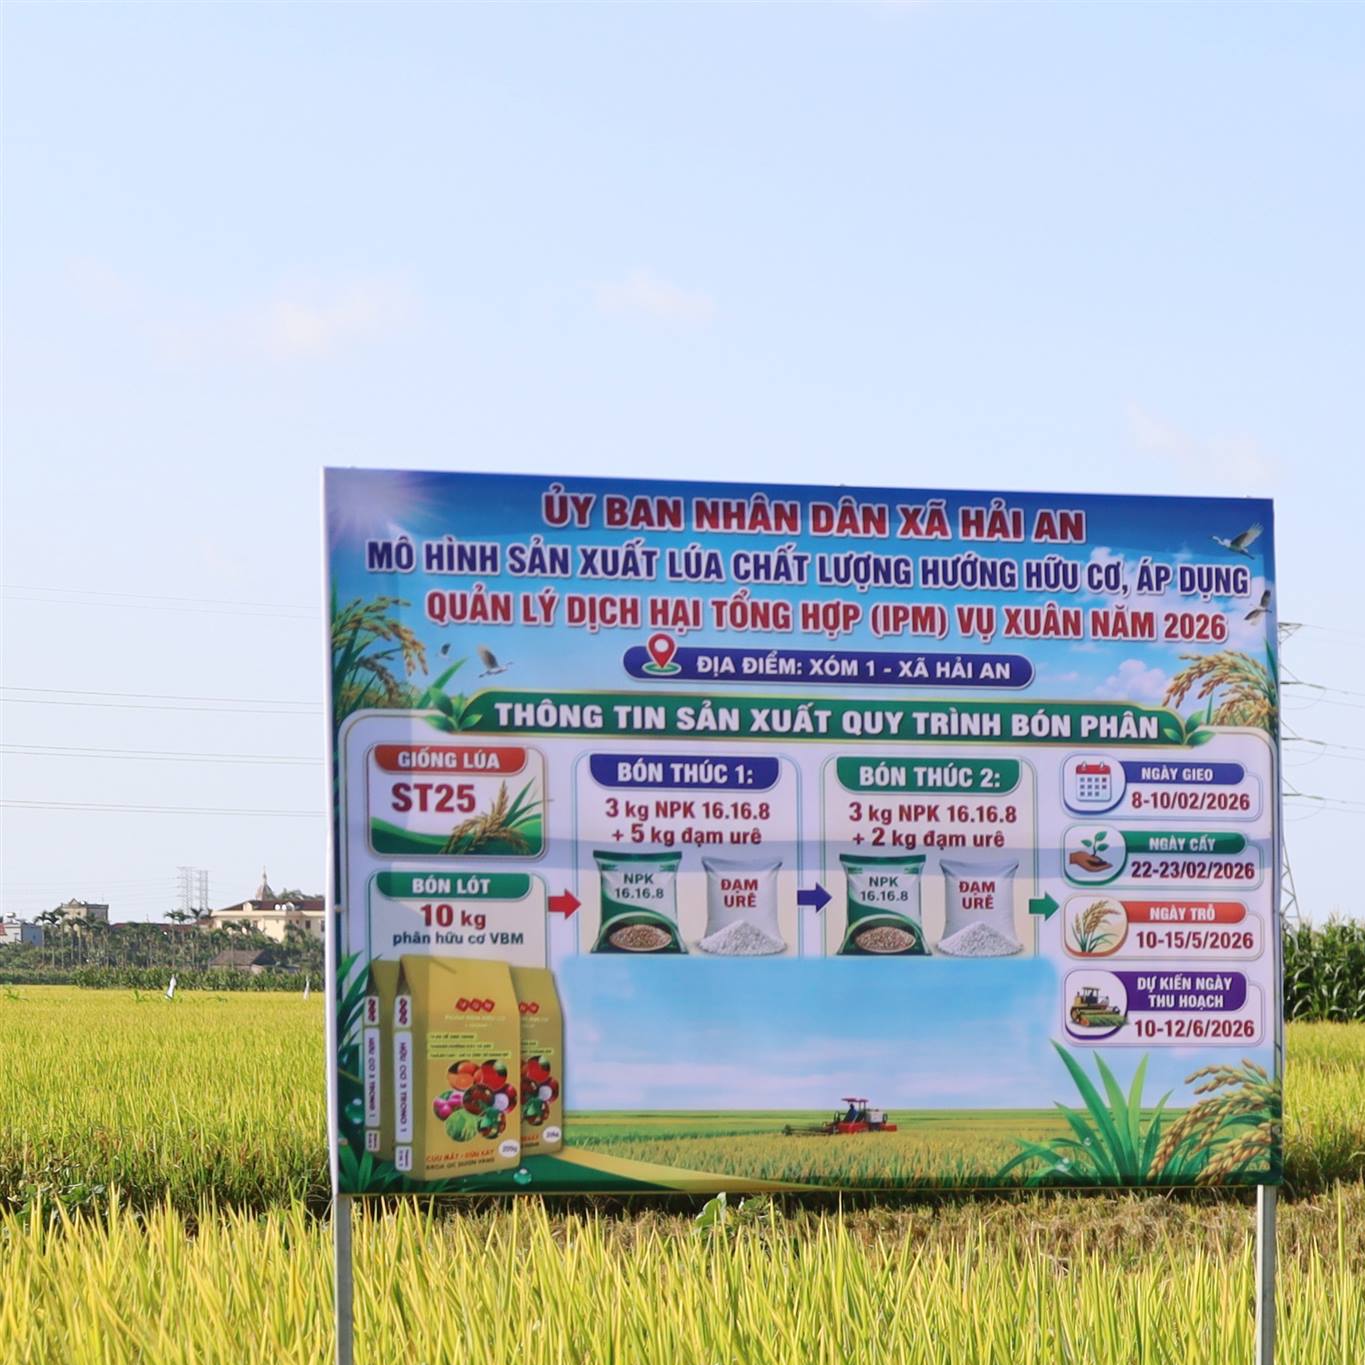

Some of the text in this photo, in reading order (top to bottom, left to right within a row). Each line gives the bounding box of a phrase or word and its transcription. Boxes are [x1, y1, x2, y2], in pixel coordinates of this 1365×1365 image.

[544, 486, 1084, 543] ỦY BAN NHÂN DÂN XÃ HẢI AN
[368, 537, 1248, 599] MÔ HÌNH SẢN XUẤT LÚA CHẤT LƯỢNG HƯỚNG HỮU CƠ, ÁP DỤNG
[427, 583, 1226, 642] QUẢN LÝ DỊCH HẠI TỔNG HỢP (IPM) VỤ XUÂN NĂM 2026
[697, 656, 735, 677] ĐỊA
[742, 651, 802, 675] ĐIỂM:
[809, 654, 857, 677] XÓM
[866, 659, 874, 677] 1
[899, 654, 928, 678] XÃ
[934, 654, 972, 679] HẢI
[979, 662, 1010, 680] AN
[494, 700, 1158, 739] THÔNG TIN SẢN XUẤT QUY TRÌNH BÓN PHÂN
[398, 749, 500, 769] GIỐNG LÚA
[617, 760, 752, 784] BÓN THÚC 1:
[859, 763, 1000, 787] BÓN THÚC 2:
[1142, 764, 1213, 782] NGÀY GIEO
[392, 783, 476, 813] ST25
[1132, 792, 1250, 810] 8-10/02/2026
[606, 799, 769, 821] 3 kg NPK 16.16.8
[849, 802, 1017, 824] 3 kg NPK 16.16.8
[612, 824, 762, 847] + 5 kg đạm urê
[853, 828, 1005, 850] + 2 kg đạm urê
[1150, 834, 1216, 852] NGÀY CẤY
[624, 873, 654, 885] NPK
[1131, 861, 1254, 879] 22-23/02/2026
[412, 874, 490, 895] BÓN LÓT
[721, 879, 758, 895] ĐẠM
[869, 876, 898, 888] NPK
[959, 880, 995, 896] ĐẠM
[614, 888, 664, 899] 16.16.8
[724, 893, 757, 908] URÊ
[860, 890, 908, 901] 16.16.8
[962, 895, 994, 910] URÊ
[421, 904, 486, 930] 10 kg
[1150, 904, 1187, 921] NGÀY
[392, 932, 524, 947] phân hữu cơ VBM
[1137, 932, 1253, 950] 10-15/5/2026
[1137, 975, 1232, 994] DỰ KIẾN NGÀY
[1149, 994, 1224, 1010] THU HOẠCH
[1135, 1020, 1254, 1038] 10-12/6/2026
